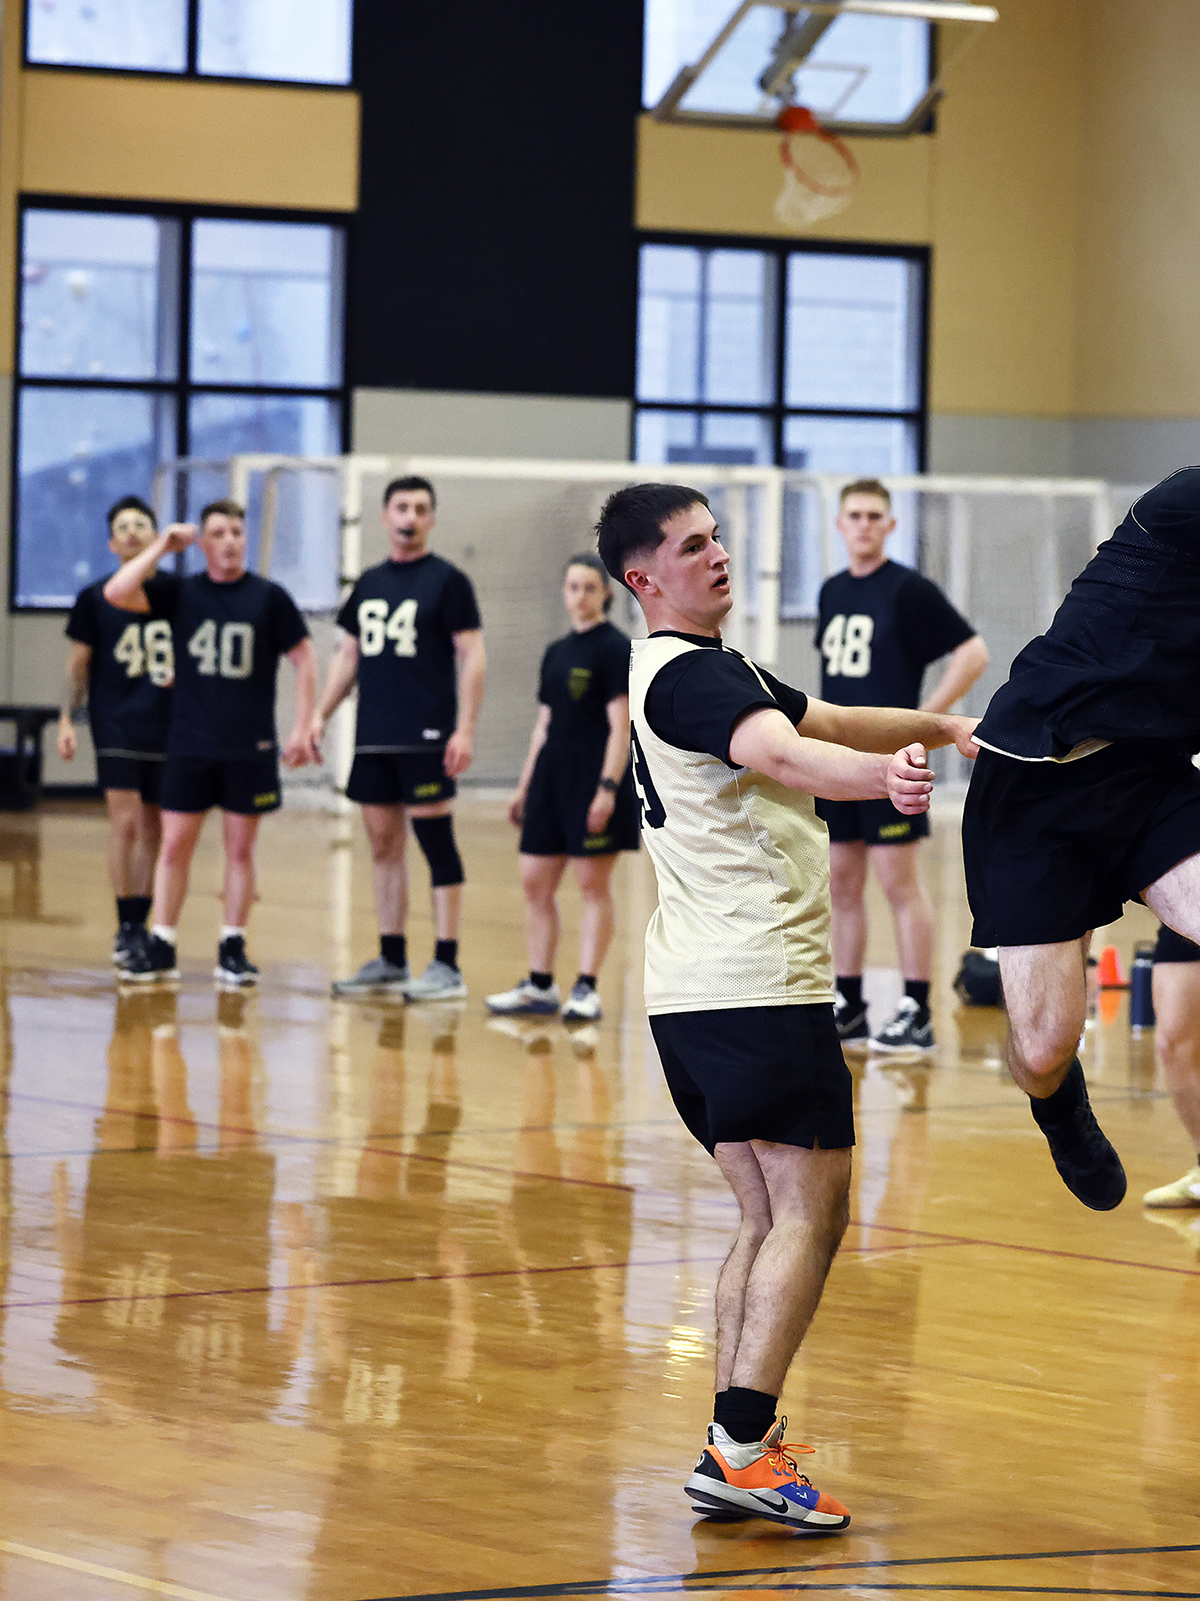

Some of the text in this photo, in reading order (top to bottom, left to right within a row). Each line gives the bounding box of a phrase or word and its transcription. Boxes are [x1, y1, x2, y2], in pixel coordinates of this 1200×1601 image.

[188, 620, 253, 678] 40
[357, 599, 418, 657] 64
[822, 613, 875, 678] 48
